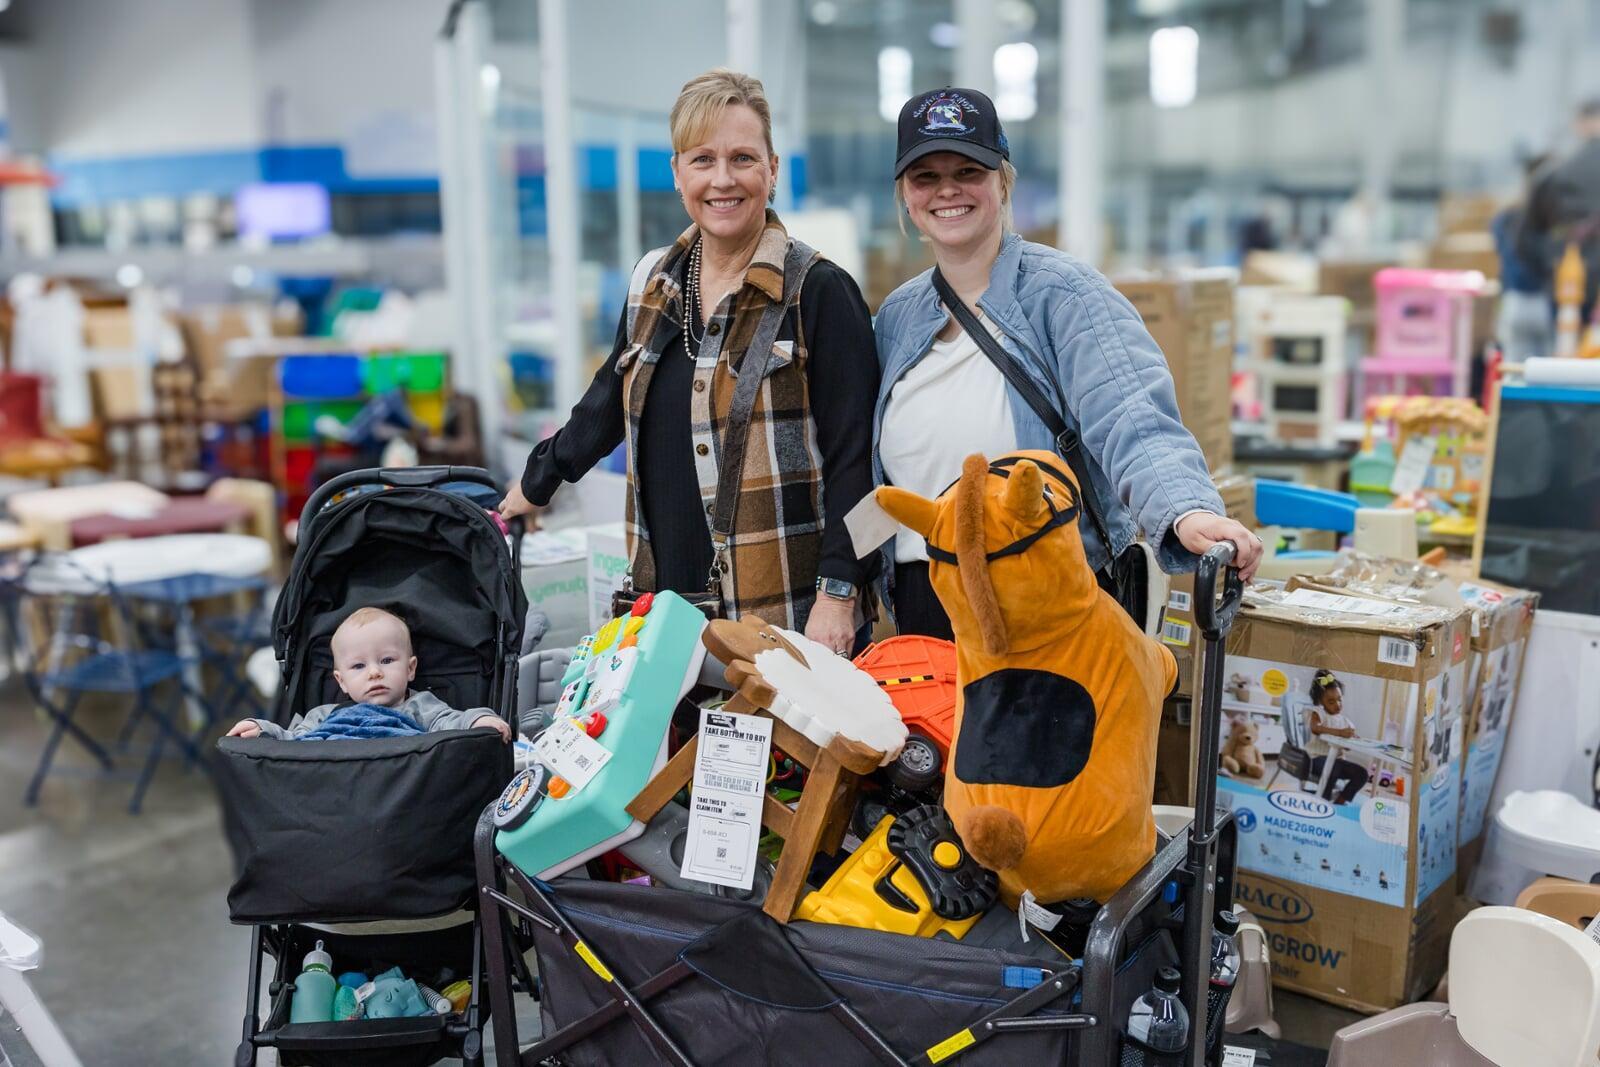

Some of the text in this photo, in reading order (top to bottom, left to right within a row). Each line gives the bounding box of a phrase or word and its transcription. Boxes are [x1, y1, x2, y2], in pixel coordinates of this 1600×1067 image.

[704, 726, 767, 743] TAKE BOTTOM TO BUY
[696, 804, 711, 812] CLAIM
[709, 798, 720, 806] THIS
[1276, 794, 1328, 815] GRACO
[1264, 815, 1335, 838] MADE2GROW
[1292, 834, 1329, 848] Highchair
[1236, 882, 1301, 915] RACO
